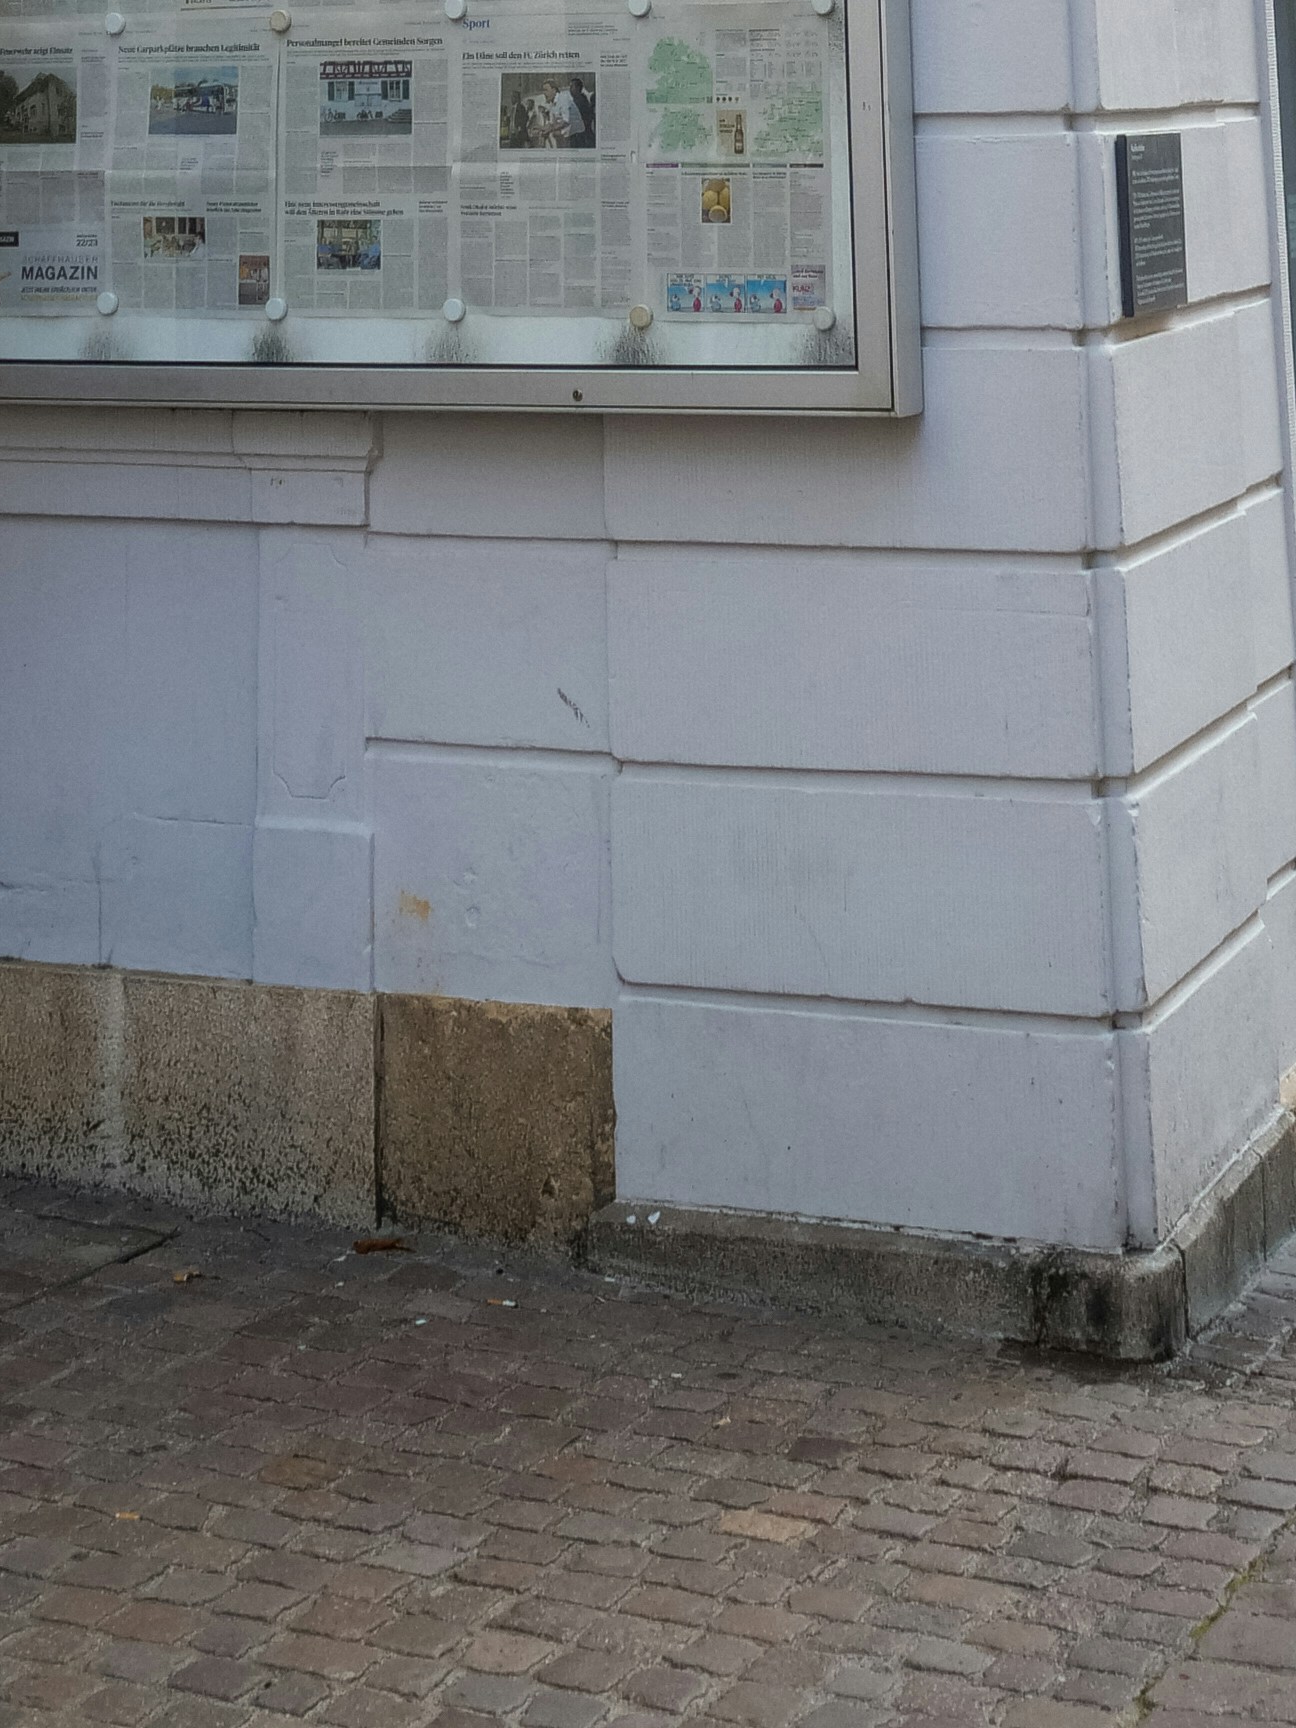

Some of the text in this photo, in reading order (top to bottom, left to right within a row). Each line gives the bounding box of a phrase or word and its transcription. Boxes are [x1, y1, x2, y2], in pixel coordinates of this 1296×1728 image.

[462, 18, 490, 31] Sport
[416, 37, 443, 47] Sorgen
[534, 50, 558, 59] Zürich
[21, 265, 98, 281] MAGAZIN
